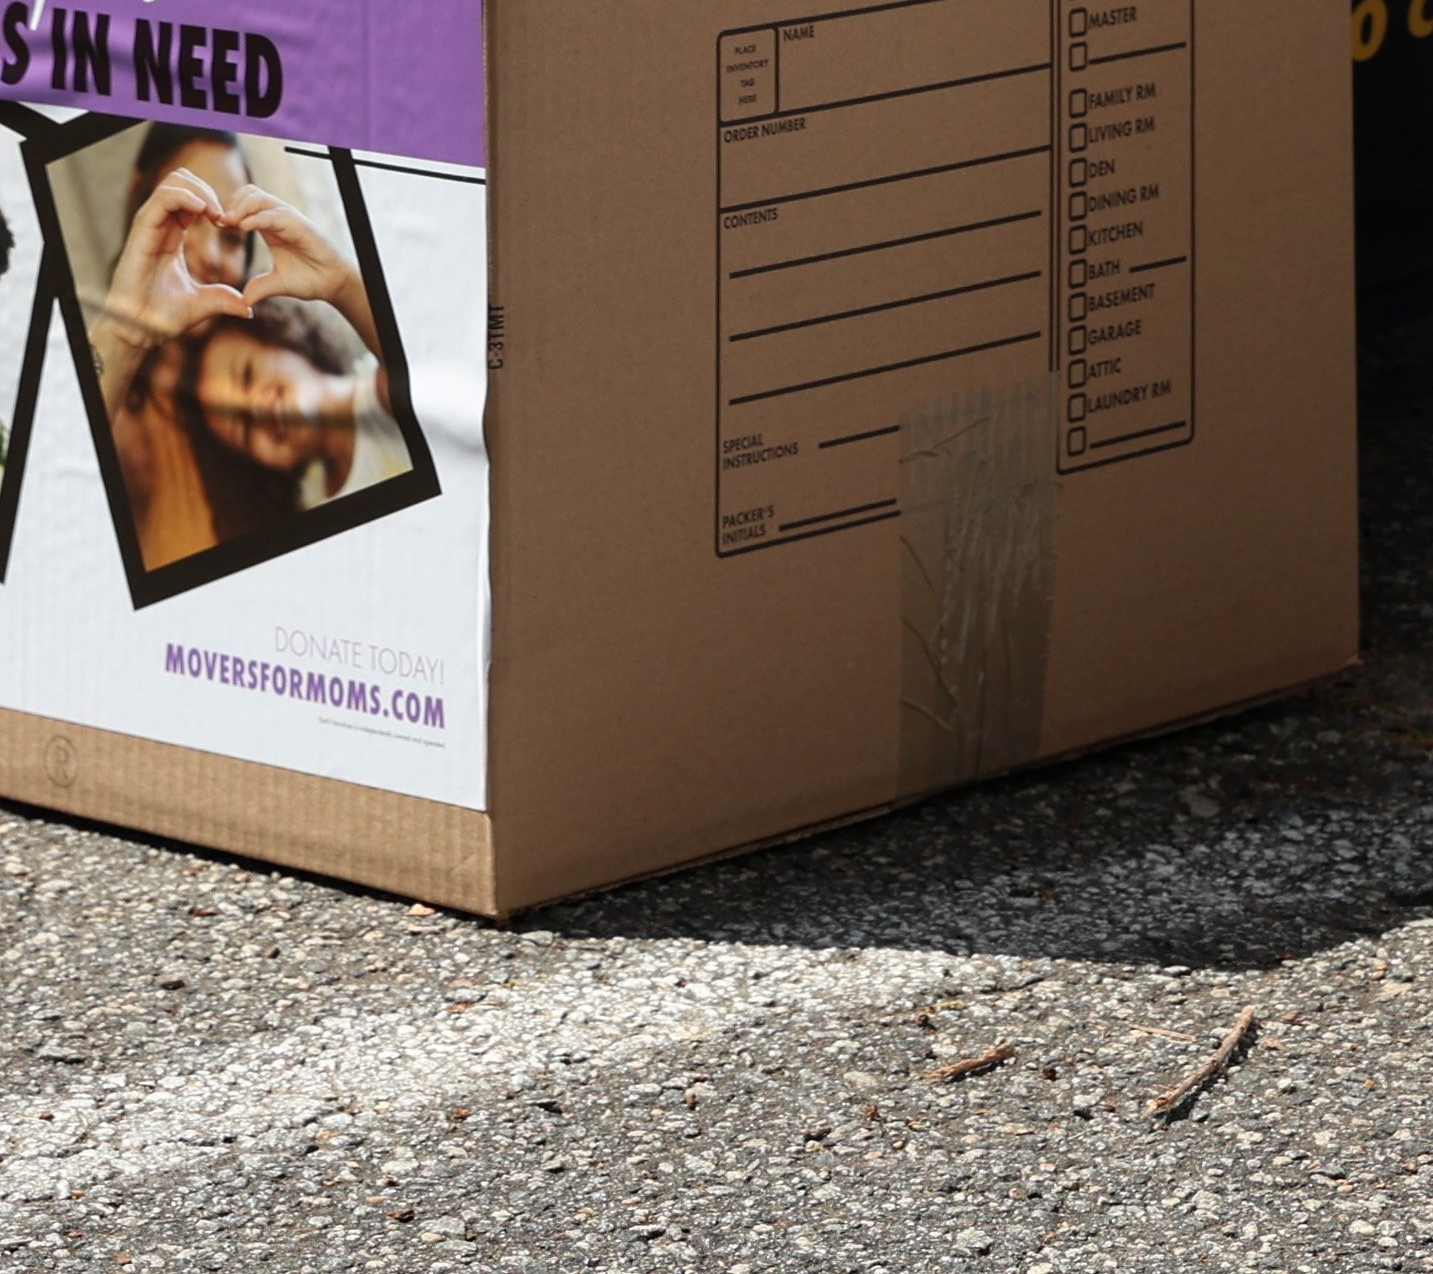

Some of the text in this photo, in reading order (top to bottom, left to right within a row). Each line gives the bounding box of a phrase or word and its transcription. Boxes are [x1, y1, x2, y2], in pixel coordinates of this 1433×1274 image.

[1088, 6, 1137, 29] MASTER
[783, 25, 815, 42] NAME
[50, 7, 111, 96] IN
[135, 18, 283, 119] NEED
[1088, 82, 1156, 109] FAMILY RM
[723, 117, 806, 143] ORDER NUMBER
[1088, 116, 1156, 143] LIVING RM
[1088, 159, 1115, 178] DEN
[1088, 183, 1160, 213] DINING RM
[723, 208, 778, 229] CONTENTS
[1088, 221, 1143, 246] KITCHEN
[1088, 259, 1121, 280] BATH
[1088, 283, 1156, 311] BASEMENT
[487, 305, 505, 370] C-3TMT
[1088, 320, 1142, 345] GARAGE
[1088, 358, 1122, 379] ATTIC
[1088, 380, 1172, 413] LAUNDRY RM
[723, 433, 764, 453] SPECIAL
[723, 442, 799, 470] INSTRUCTIONS
[722, 524, 766, 544] INITIALS
[275, 626, 445, 684] DONATE TODAY!
[165, 643, 446, 729] MOVERSFORMOMS.COM
